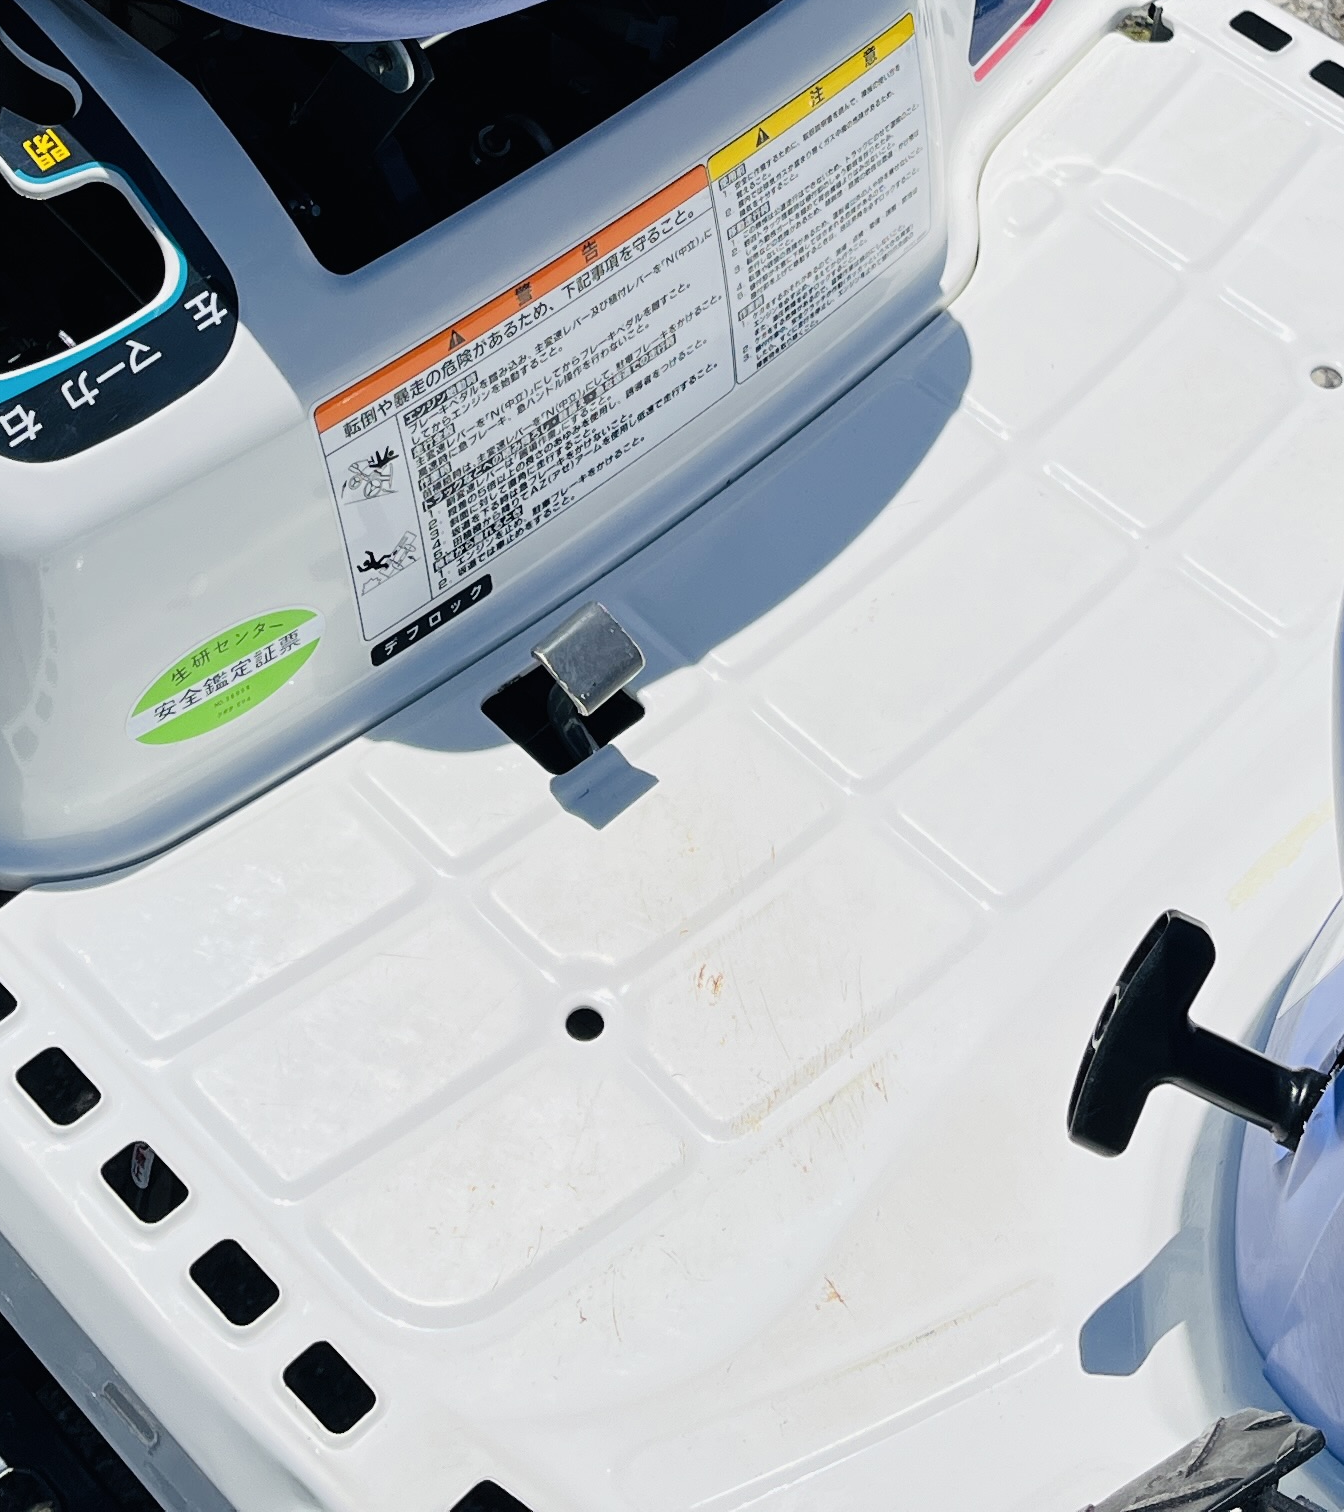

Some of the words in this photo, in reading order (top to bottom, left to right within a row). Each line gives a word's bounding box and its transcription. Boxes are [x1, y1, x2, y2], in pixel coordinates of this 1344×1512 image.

[809, 42, 877, 108] 注意
[23, 128, 71, 172] 閉
[514, 236, 599, 308] 警告
[183, 290, 229, 331] 左
[60, 338, 163, 410] マーカ
[170, 619, 285, 685] 生研センター
[383, 583, 483, 657] デフロック
[154, 629, 303, 723] 安全鑑定証票
